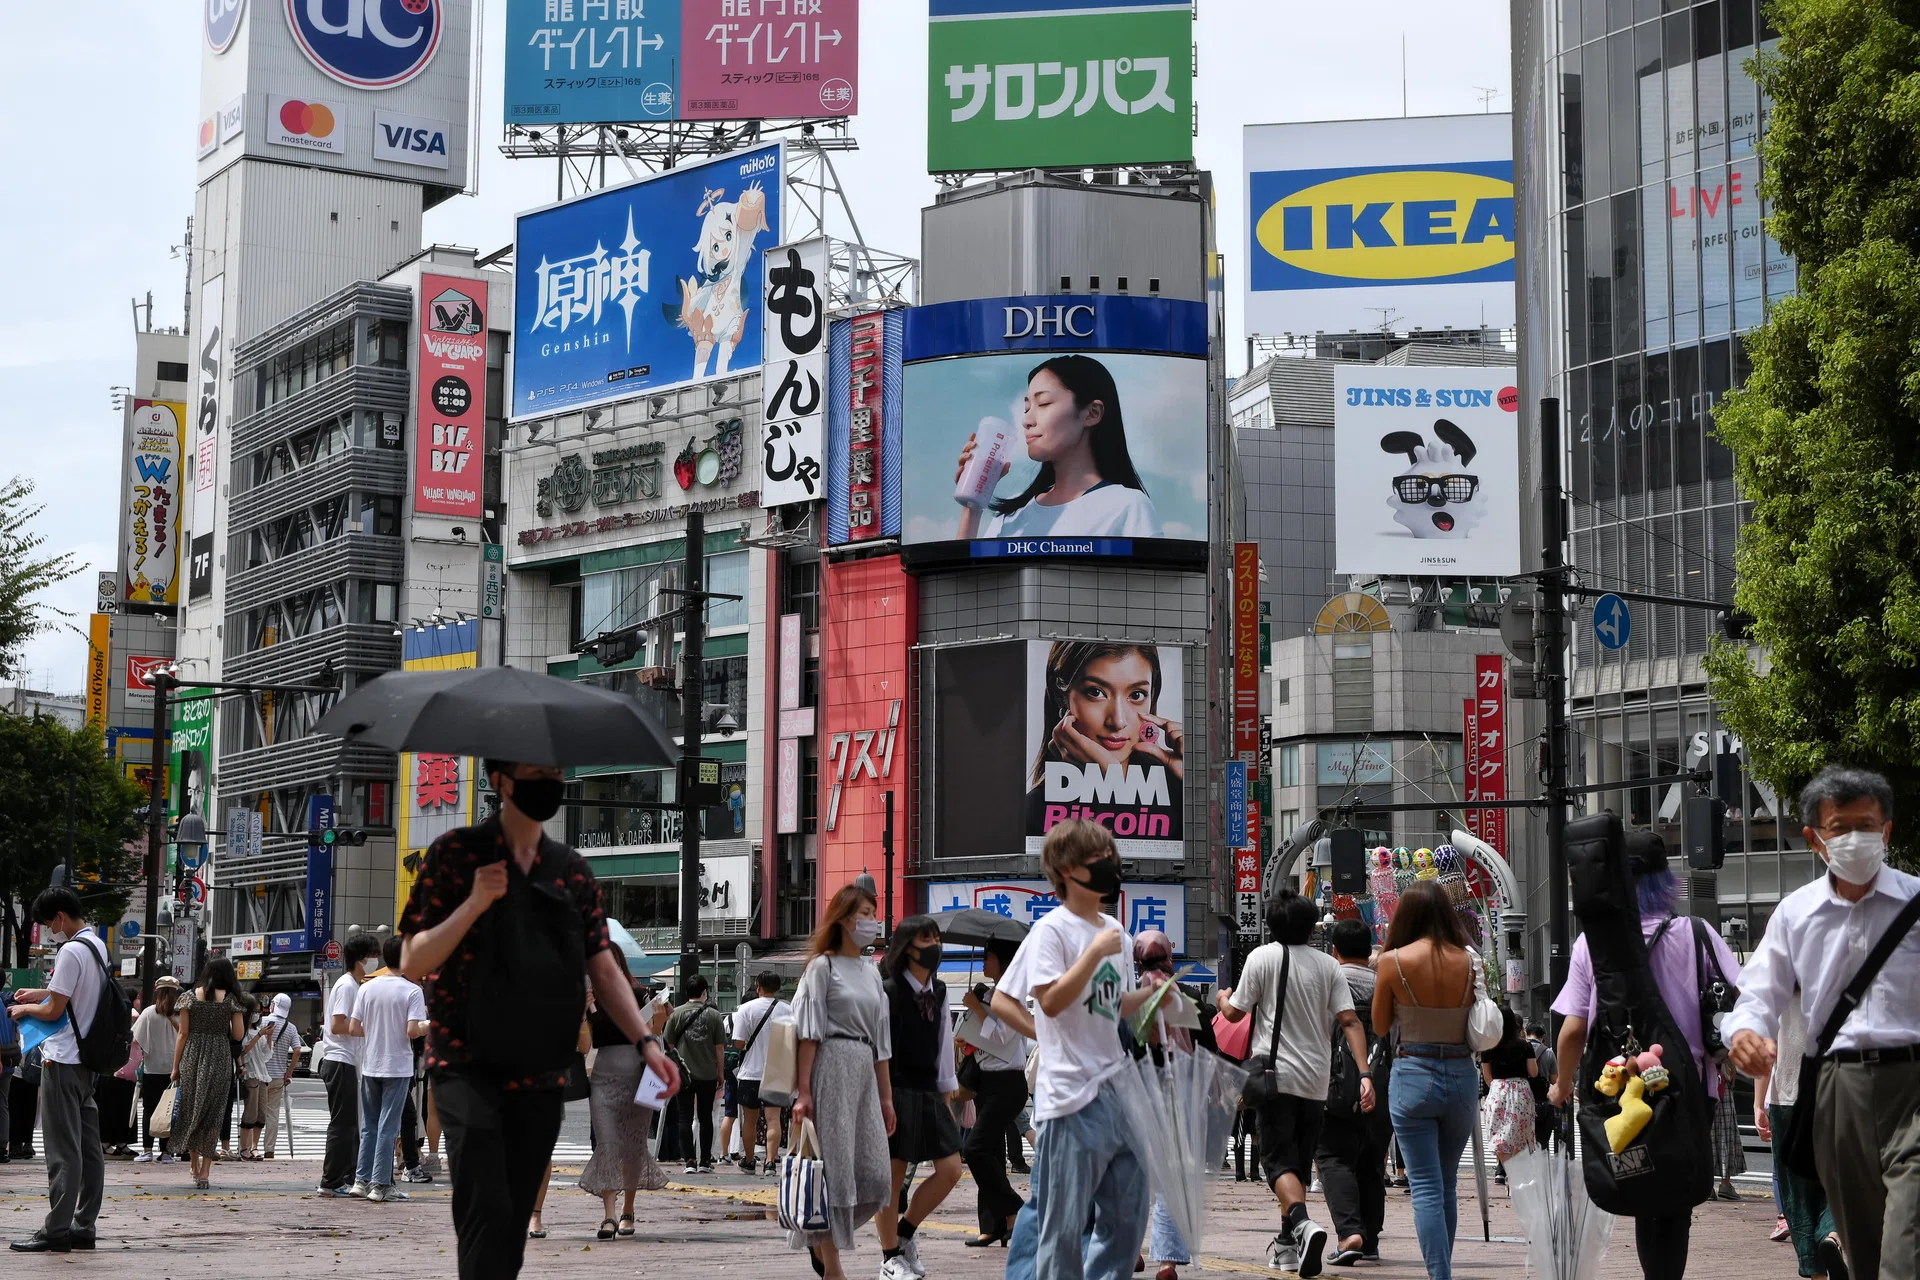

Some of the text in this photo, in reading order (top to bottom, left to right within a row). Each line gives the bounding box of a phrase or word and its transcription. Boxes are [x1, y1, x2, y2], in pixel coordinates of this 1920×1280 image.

[528, 26, 664, 70] ダイレクト
[705, 22, 843, 66] ダイレクト
[544, 77, 641, 90] スティック ミント 16包
[721, 72, 819, 85] スティック ピーチ 16包
[945, 57, 1175, 122] サロンパス
[643, 92, 672, 106] 生薬
[822, 88, 851, 101] 生薬
[223, 105, 241, 131] VISA
[282, 134, 333, 149] mastercard
[379, 123, 446, 155] VISA
[1671, 172, 1742, 219] LIVE
[1283, 197, 1515, 251] IKEA
[1692, 230, 1738, 251] PRFET
[530, 204, 651, 354] 原神
[1003, 305, 1095, 338] DHC
[423, 334, 483, 362] VANGUARD
[541, 331, 610, 357] Genshin
[764, 248, 822, 495] もんじゃ
[439, 386, 466, 396] 10:00
[537, 387, 555, 398] PS5
[560, 383, 578, 393] PS4
[582, 378, 605, 389] Windows
[1347, 387, 1493, 408] JINS & SUN
[433, 423, 469, 448] B1F
[847, 321, 876, 528] 三千里薬品
[432, 450, 470, 473] B2F
[983, 443, 1001, 473] Protein
[422, 486, 475, 503] VILLAGE VANGUARD
[1007, 540, 1094, 554] DHC Channel
[194, 551, 210, 579] 7F
[1239, 549, 1254, 678] クスリのことなら
[183, 699, 211, 723] おとなの
[1479, 669, 1501, 778] カラオケ
[825, 700, 902, 832] クスリ
[1044, 761, 1171, 806] DMM
[1231, 766, 1242, 842] 大盛堂商事ビル
[235, 811, 246, 855] 渋谷駅前
[251, 814, 260, 855] スクランブル式
[629, 829, 652, 845] DARTS
[313, 888, 324, 938] みずほ銀行
[175, 924, 186, 977] 道玄坂
